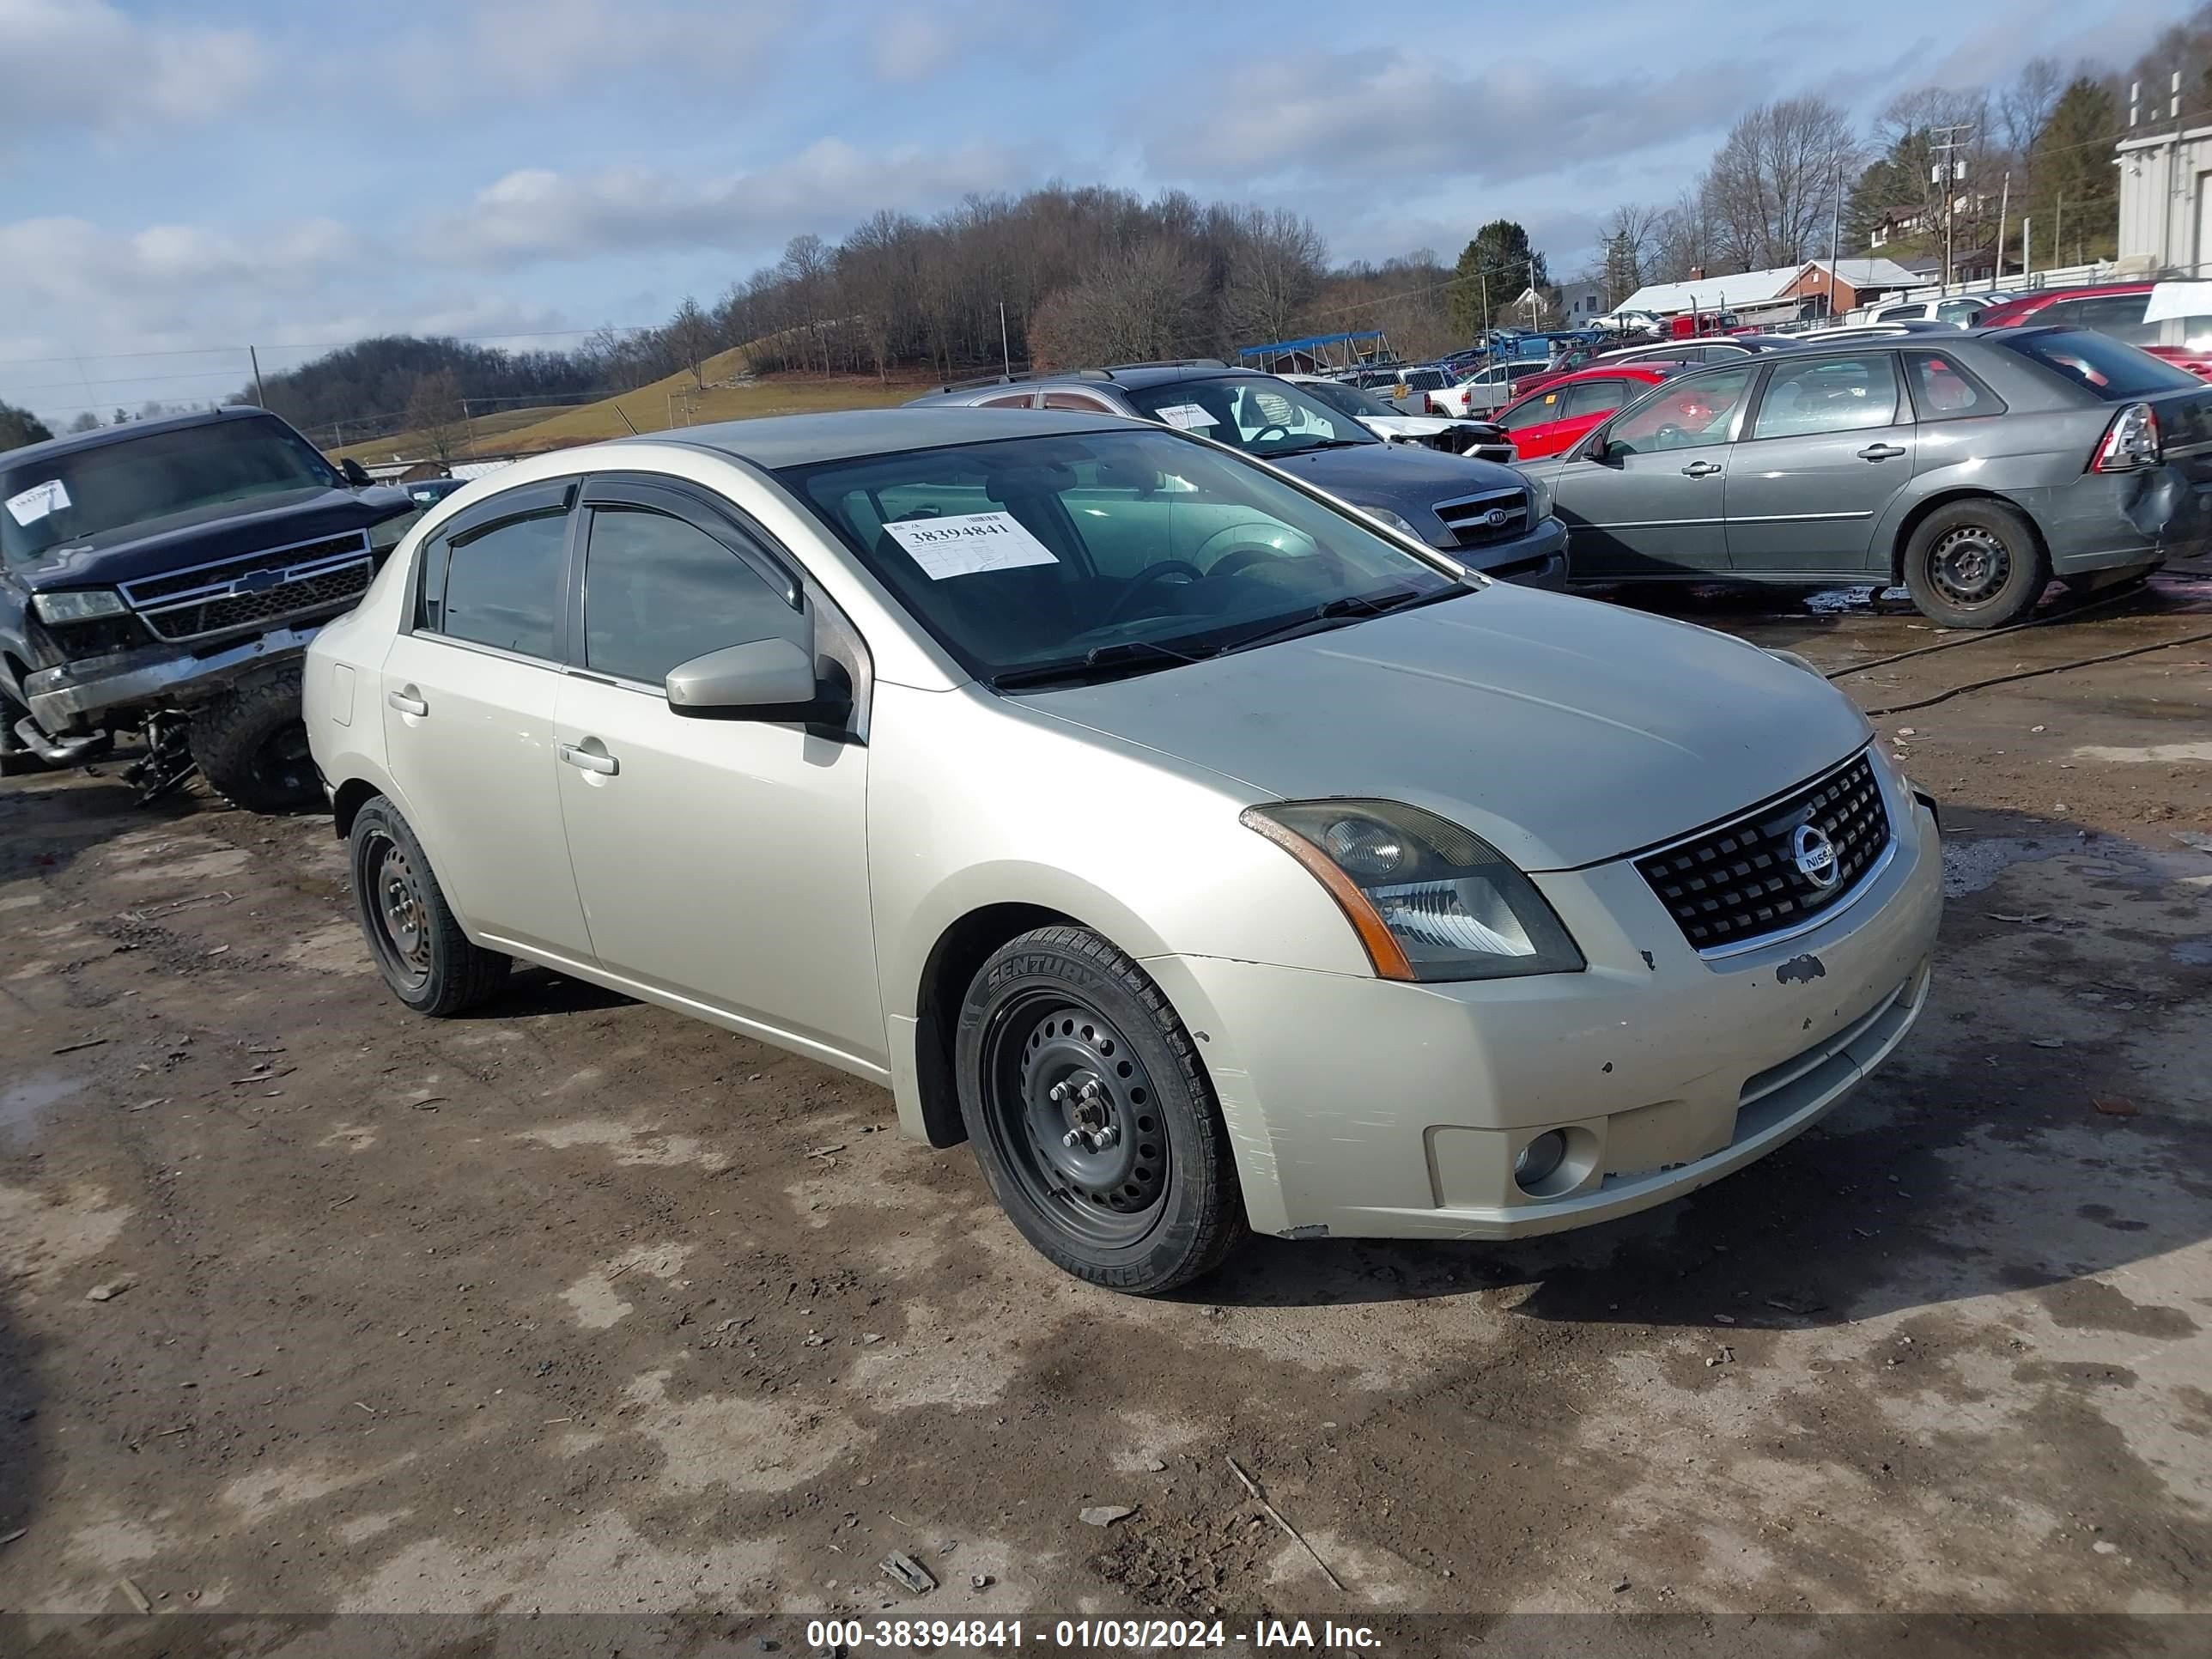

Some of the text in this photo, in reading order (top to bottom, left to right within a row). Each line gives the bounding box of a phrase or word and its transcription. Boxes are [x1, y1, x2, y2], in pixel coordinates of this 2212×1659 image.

[1490, 512, 1505, 523] KIA
[908, 523, 1010, 544] 38394841
[1805, 845, 1834, 869] NISSA
[988, 955, 1105, 994] SENTURY
